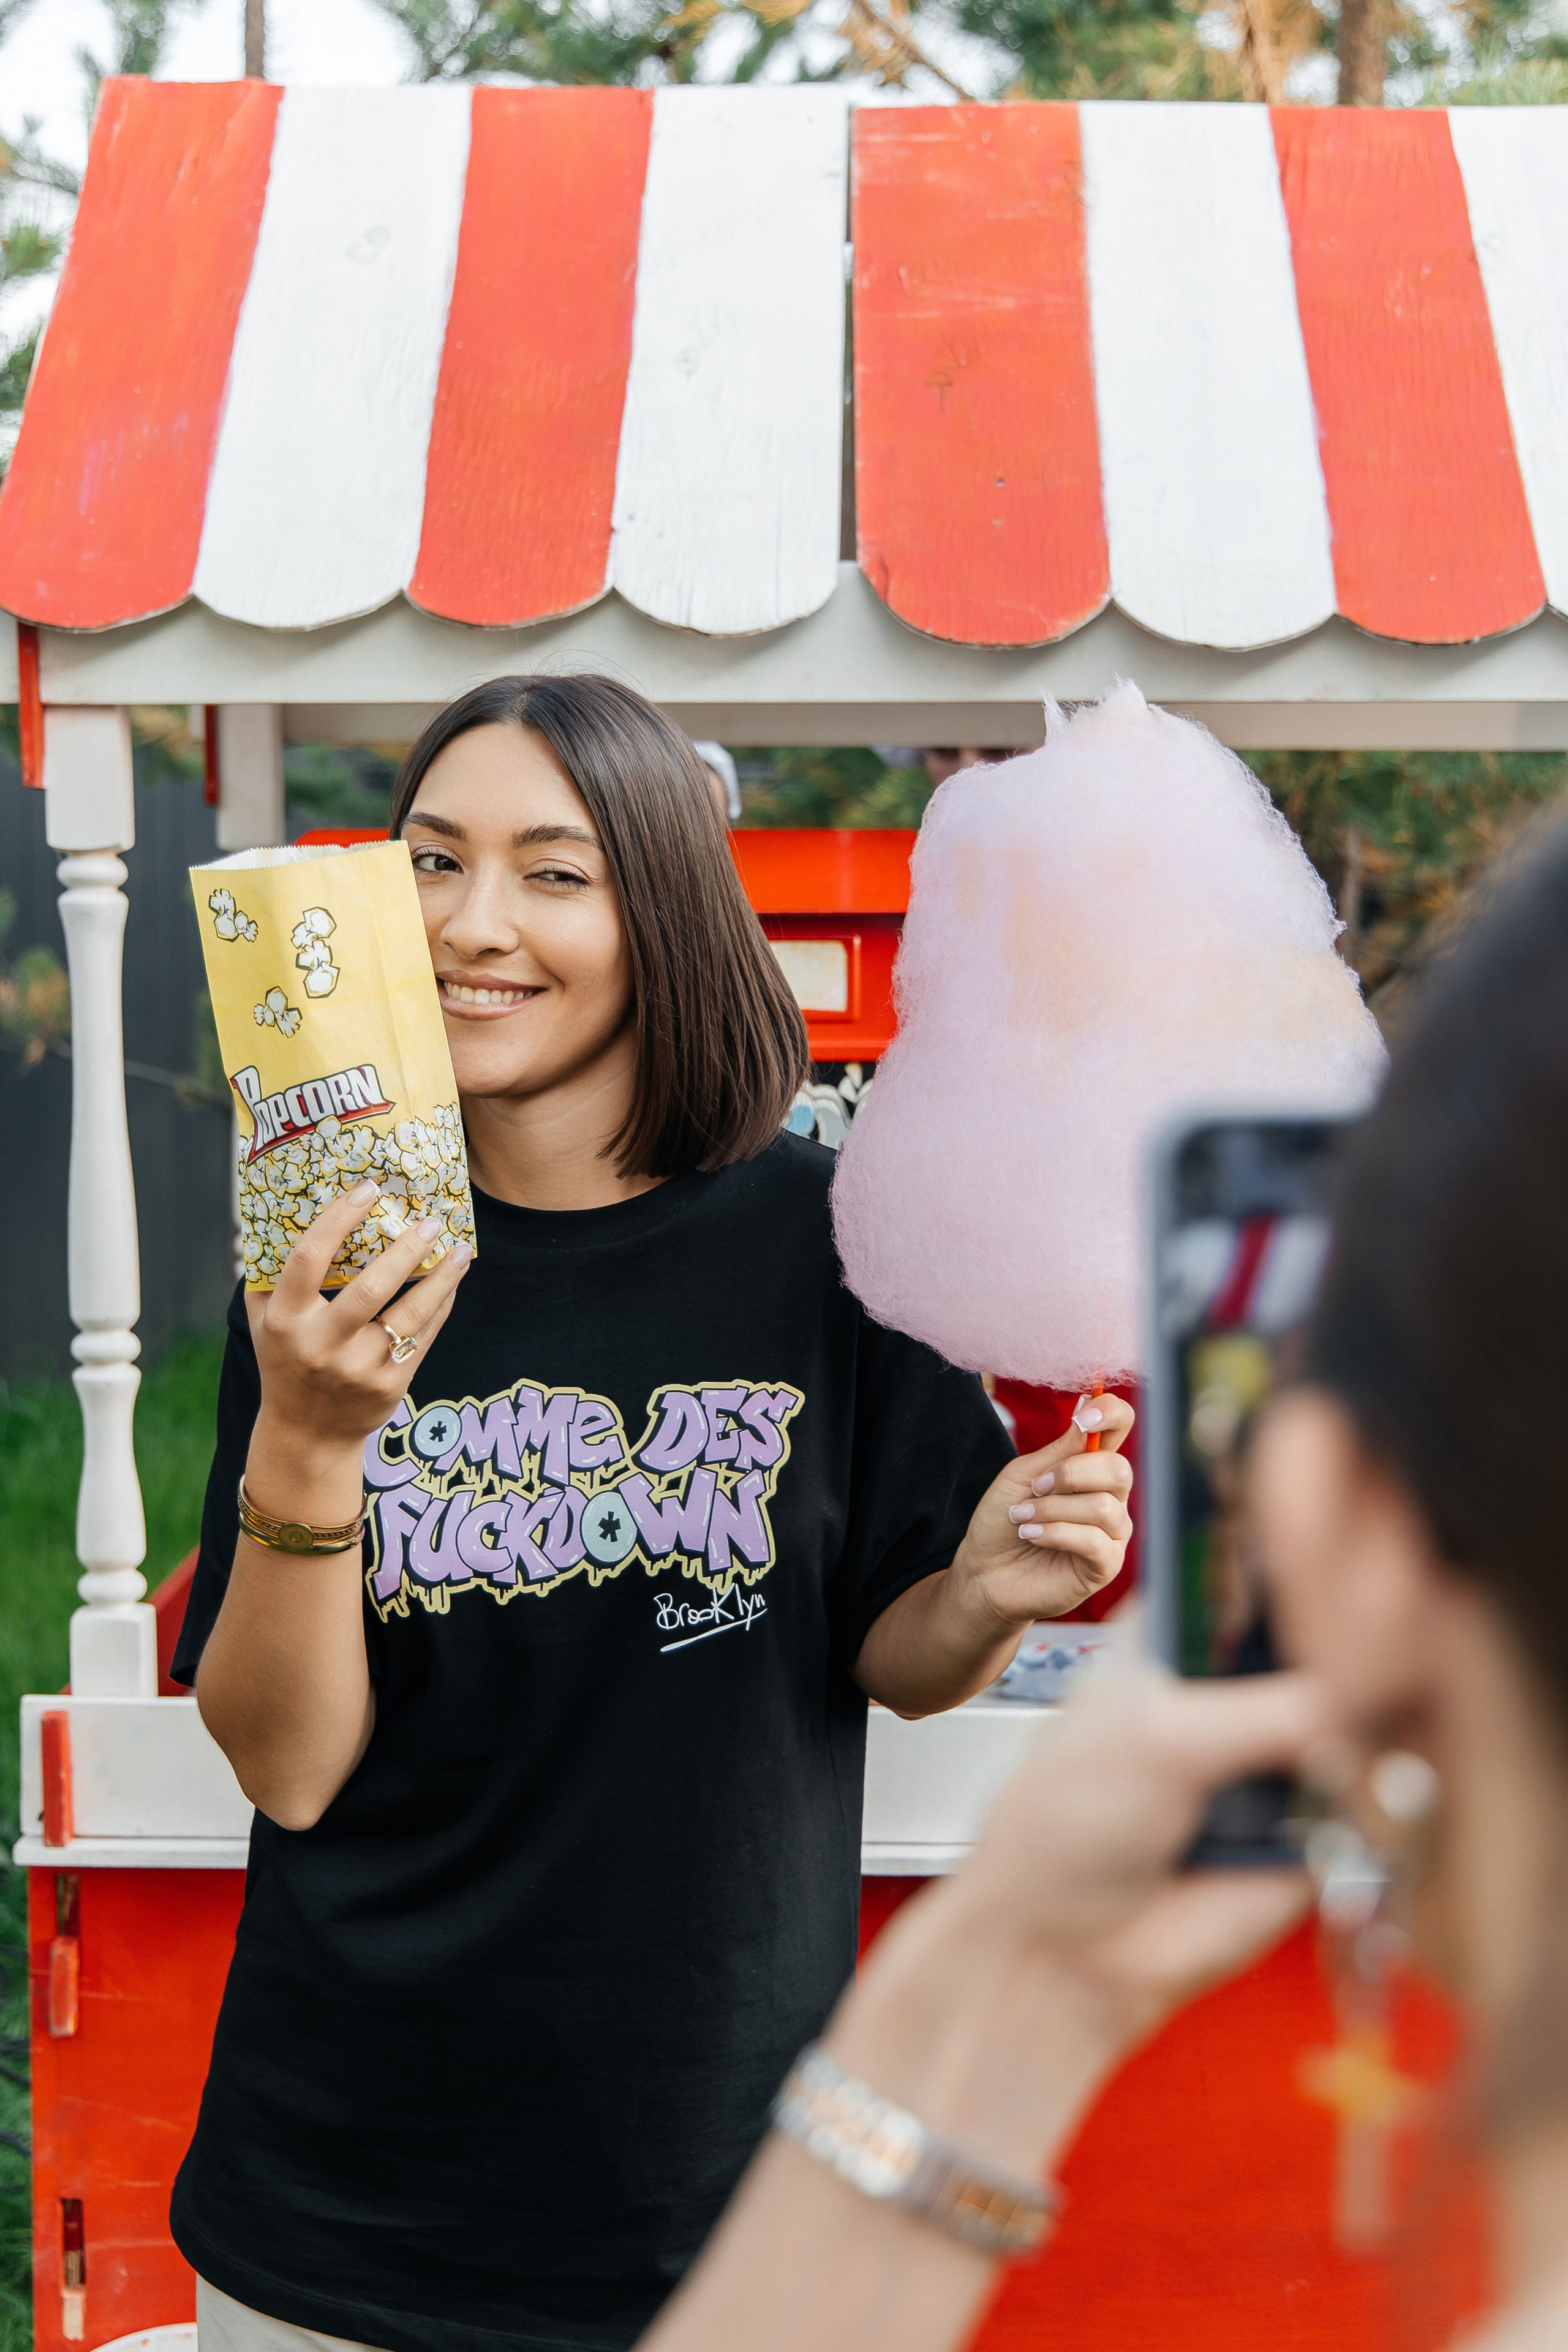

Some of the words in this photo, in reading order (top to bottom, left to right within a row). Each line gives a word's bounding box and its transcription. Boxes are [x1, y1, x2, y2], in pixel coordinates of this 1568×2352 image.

[230, 1064, 386, 1155] POPCORN
[639, 1387, 798, 1471] DES
[371, 1467, 771, 1600] FUCKDOWN
